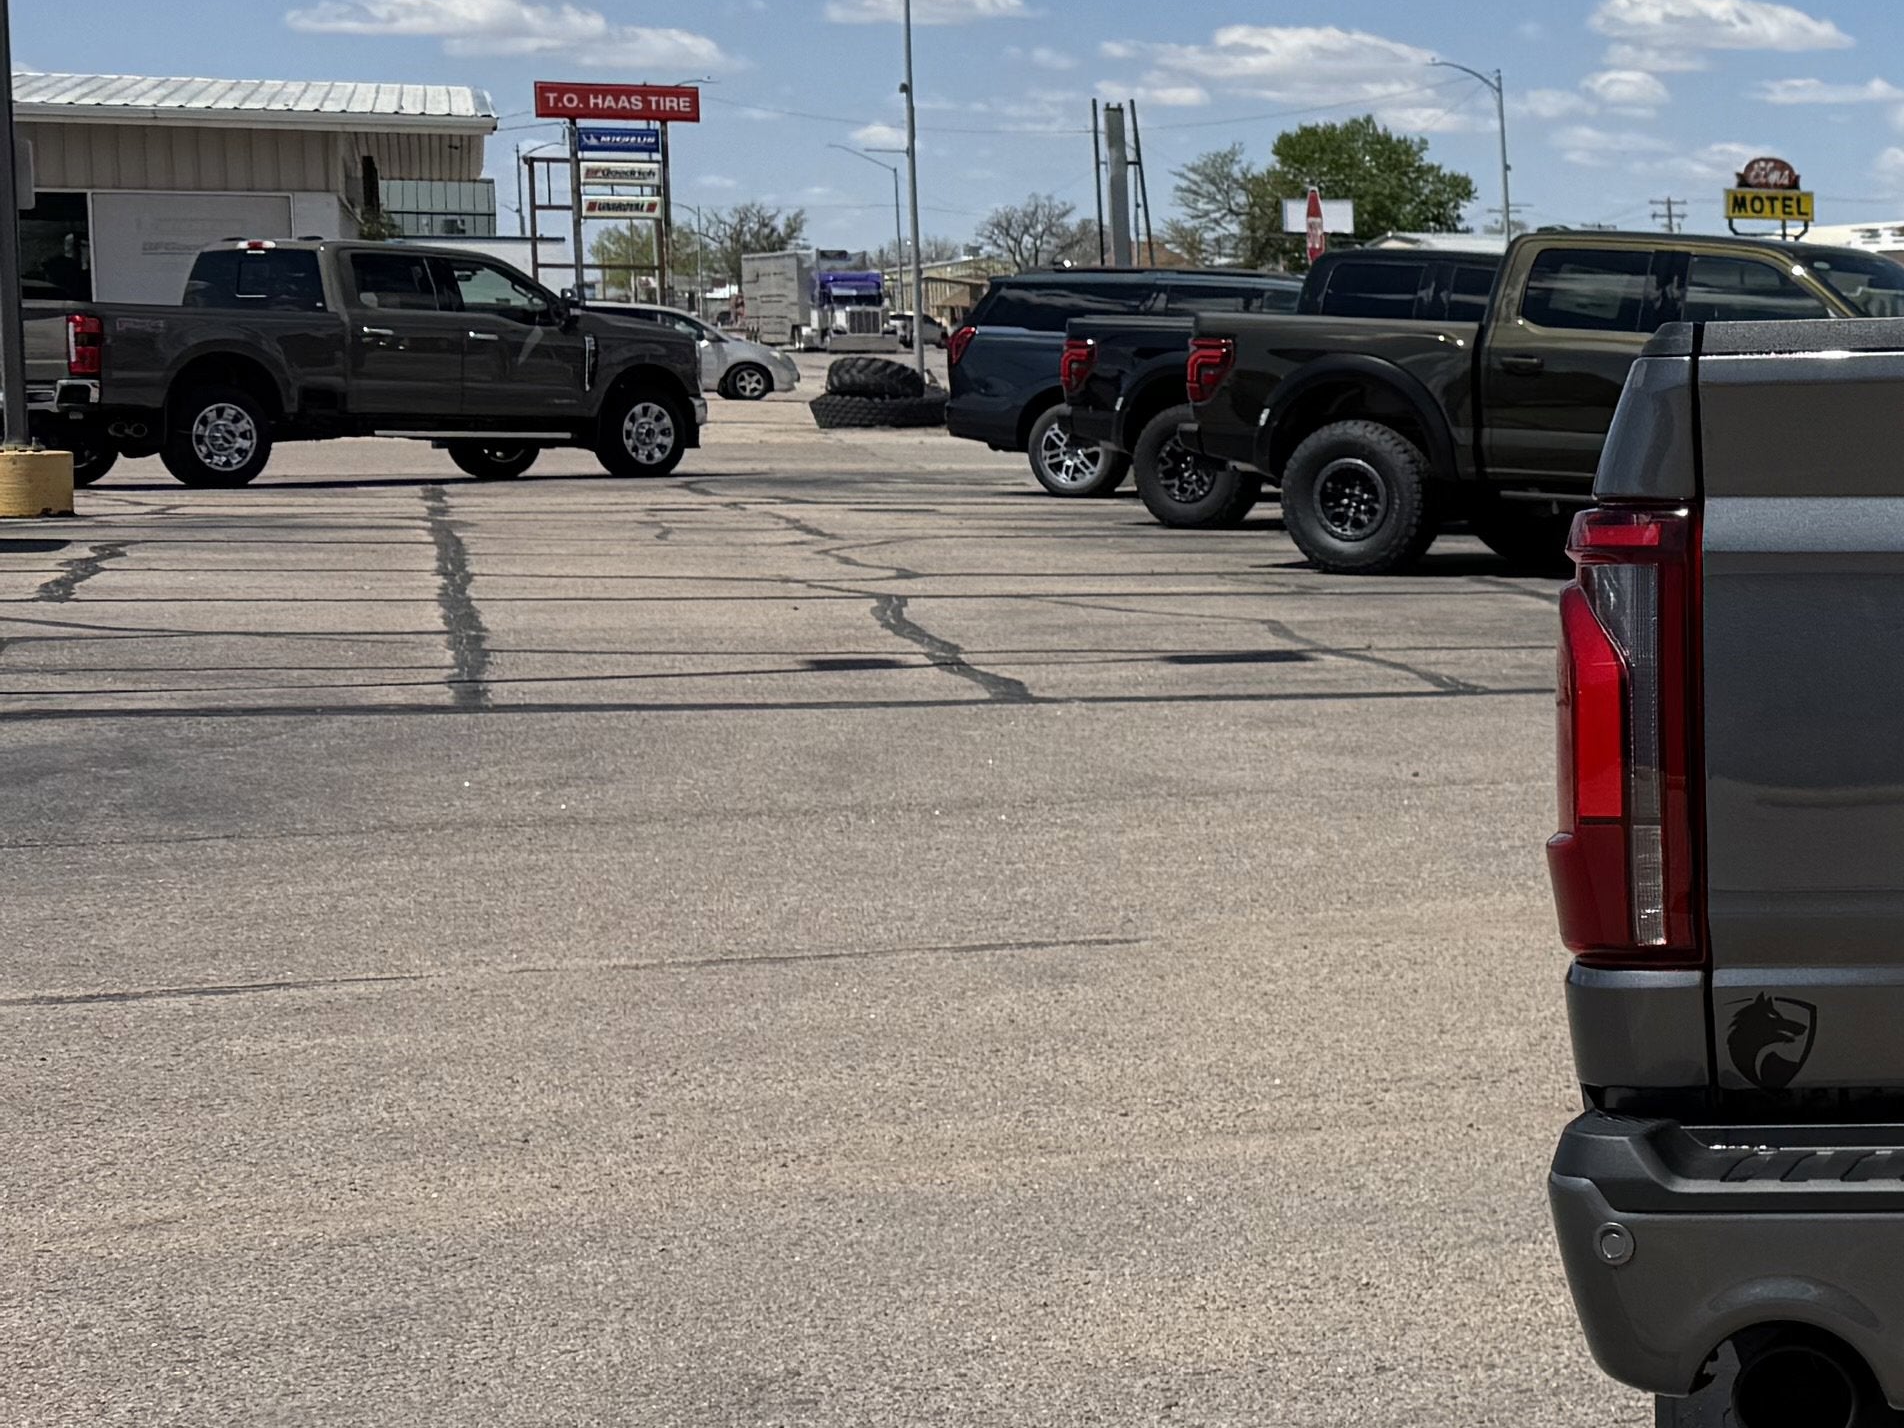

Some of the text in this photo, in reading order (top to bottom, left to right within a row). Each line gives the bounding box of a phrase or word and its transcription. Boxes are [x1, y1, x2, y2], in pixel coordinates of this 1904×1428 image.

[544, 93, 692, 112] T.O. HAAS TIRE
[1731, 195, 1809, 216] MOTEL
